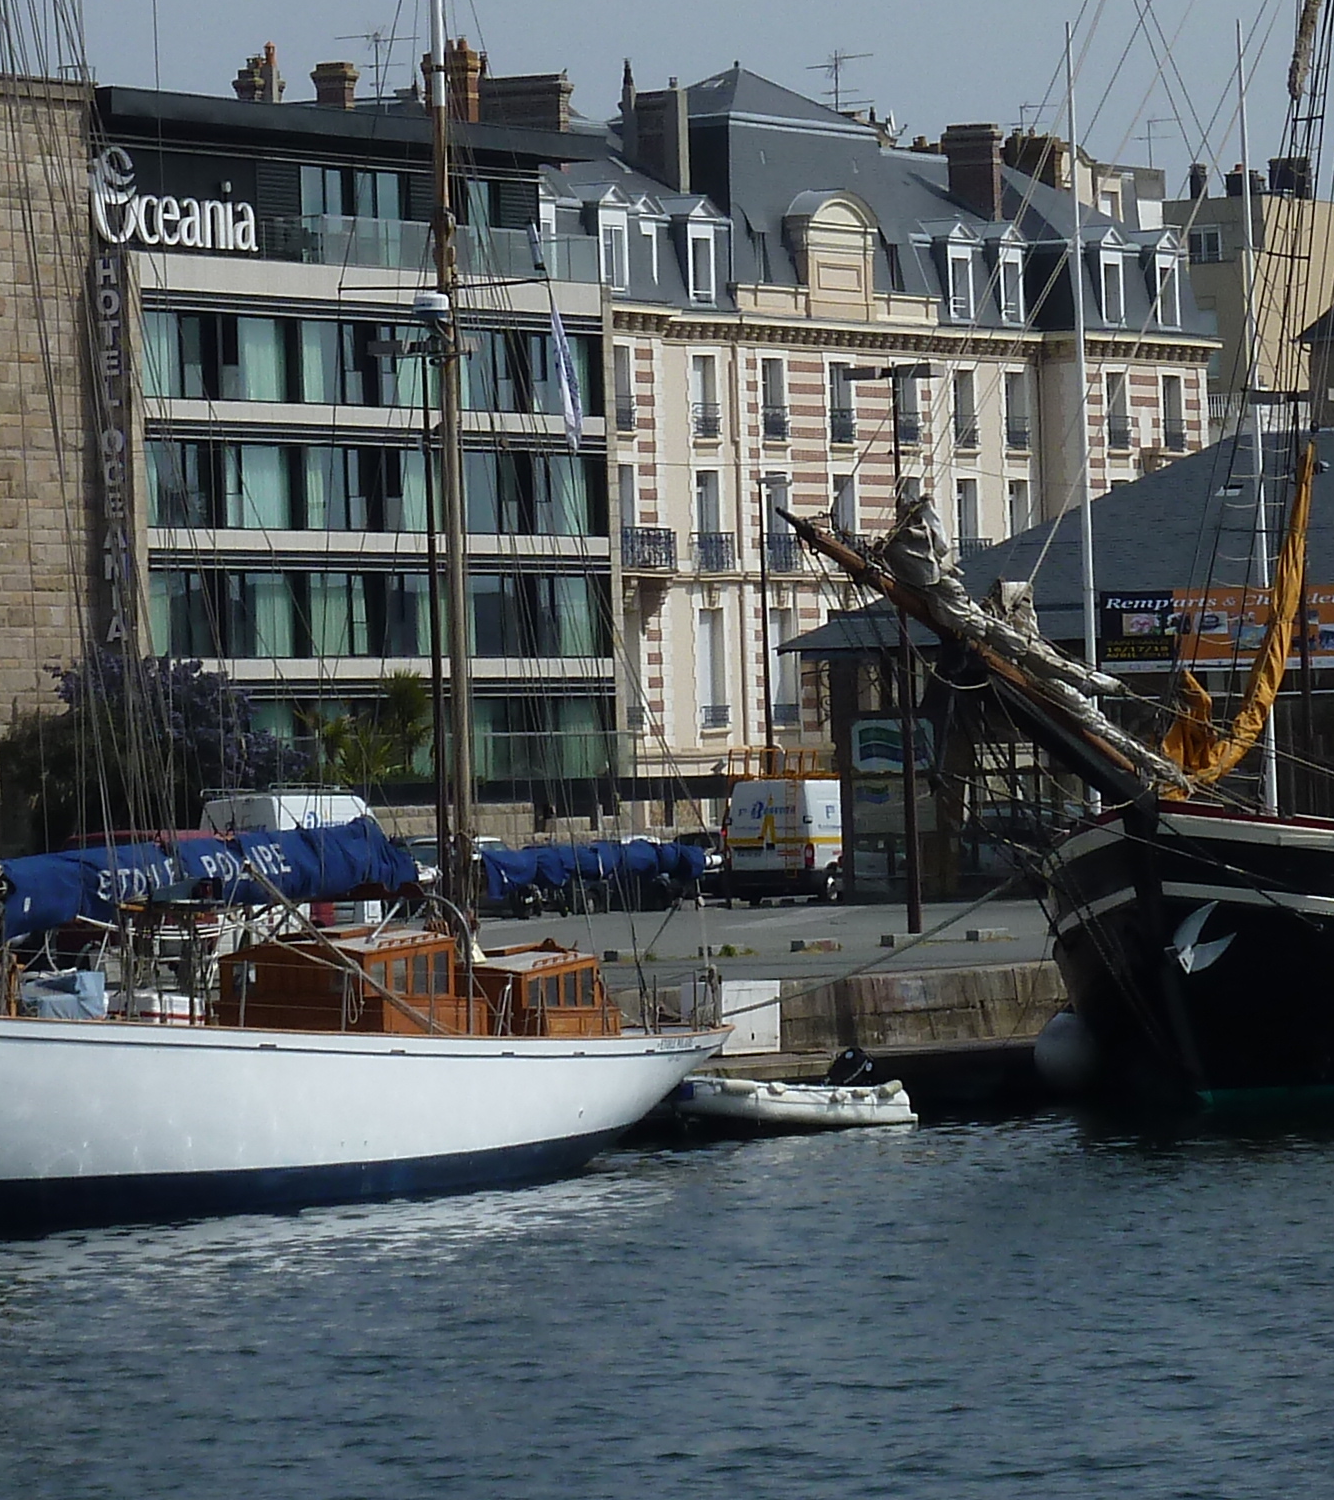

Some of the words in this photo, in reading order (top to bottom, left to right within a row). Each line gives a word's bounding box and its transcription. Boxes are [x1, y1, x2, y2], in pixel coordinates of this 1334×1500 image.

[92, 146, 259, 252] Oceania
[95, 258, 121, 408] HOTEL
[1105, 596, 1218, 611] Remp'arts
[200, 843, 292, 884] POLIRE
